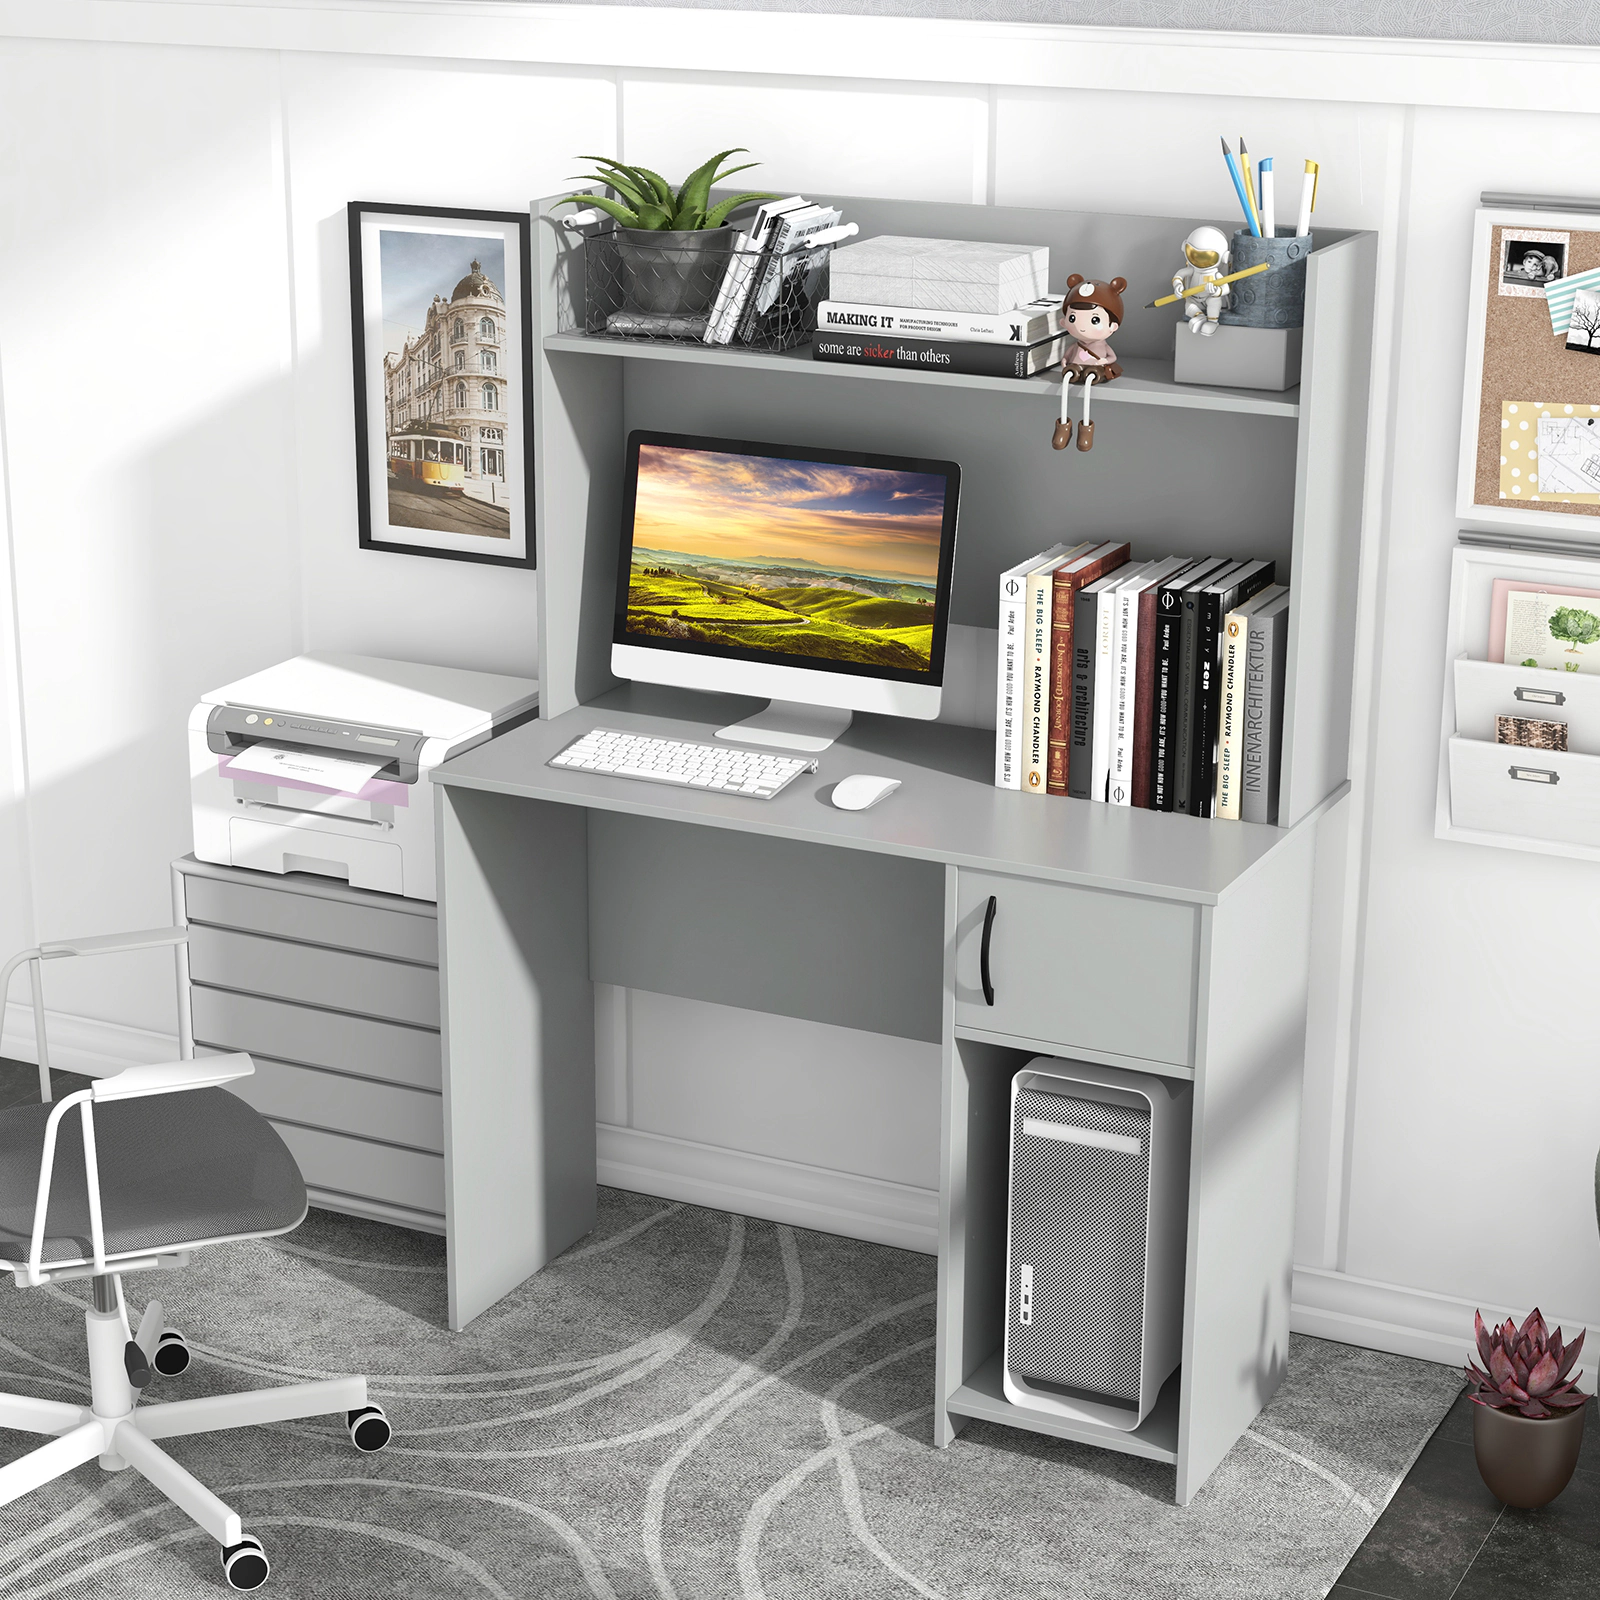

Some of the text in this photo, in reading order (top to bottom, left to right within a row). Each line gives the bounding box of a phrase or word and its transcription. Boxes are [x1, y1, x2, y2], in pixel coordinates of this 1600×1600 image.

[766, 240, 785, 276] DESTNATION
[826, 312, 893, 328] MAKING IT
[819, 343, 950, 364] some are sicker than others
[1076, 649, 1090, 669] arts
[1227, 644, 1235, 689] CHANDLER
[1074, 685, 1090, 746] architecture
[1246, 630, 1265, 792] INNENARCHITEKTUR
[1032, 717, 1040, 764] CHANDLER
